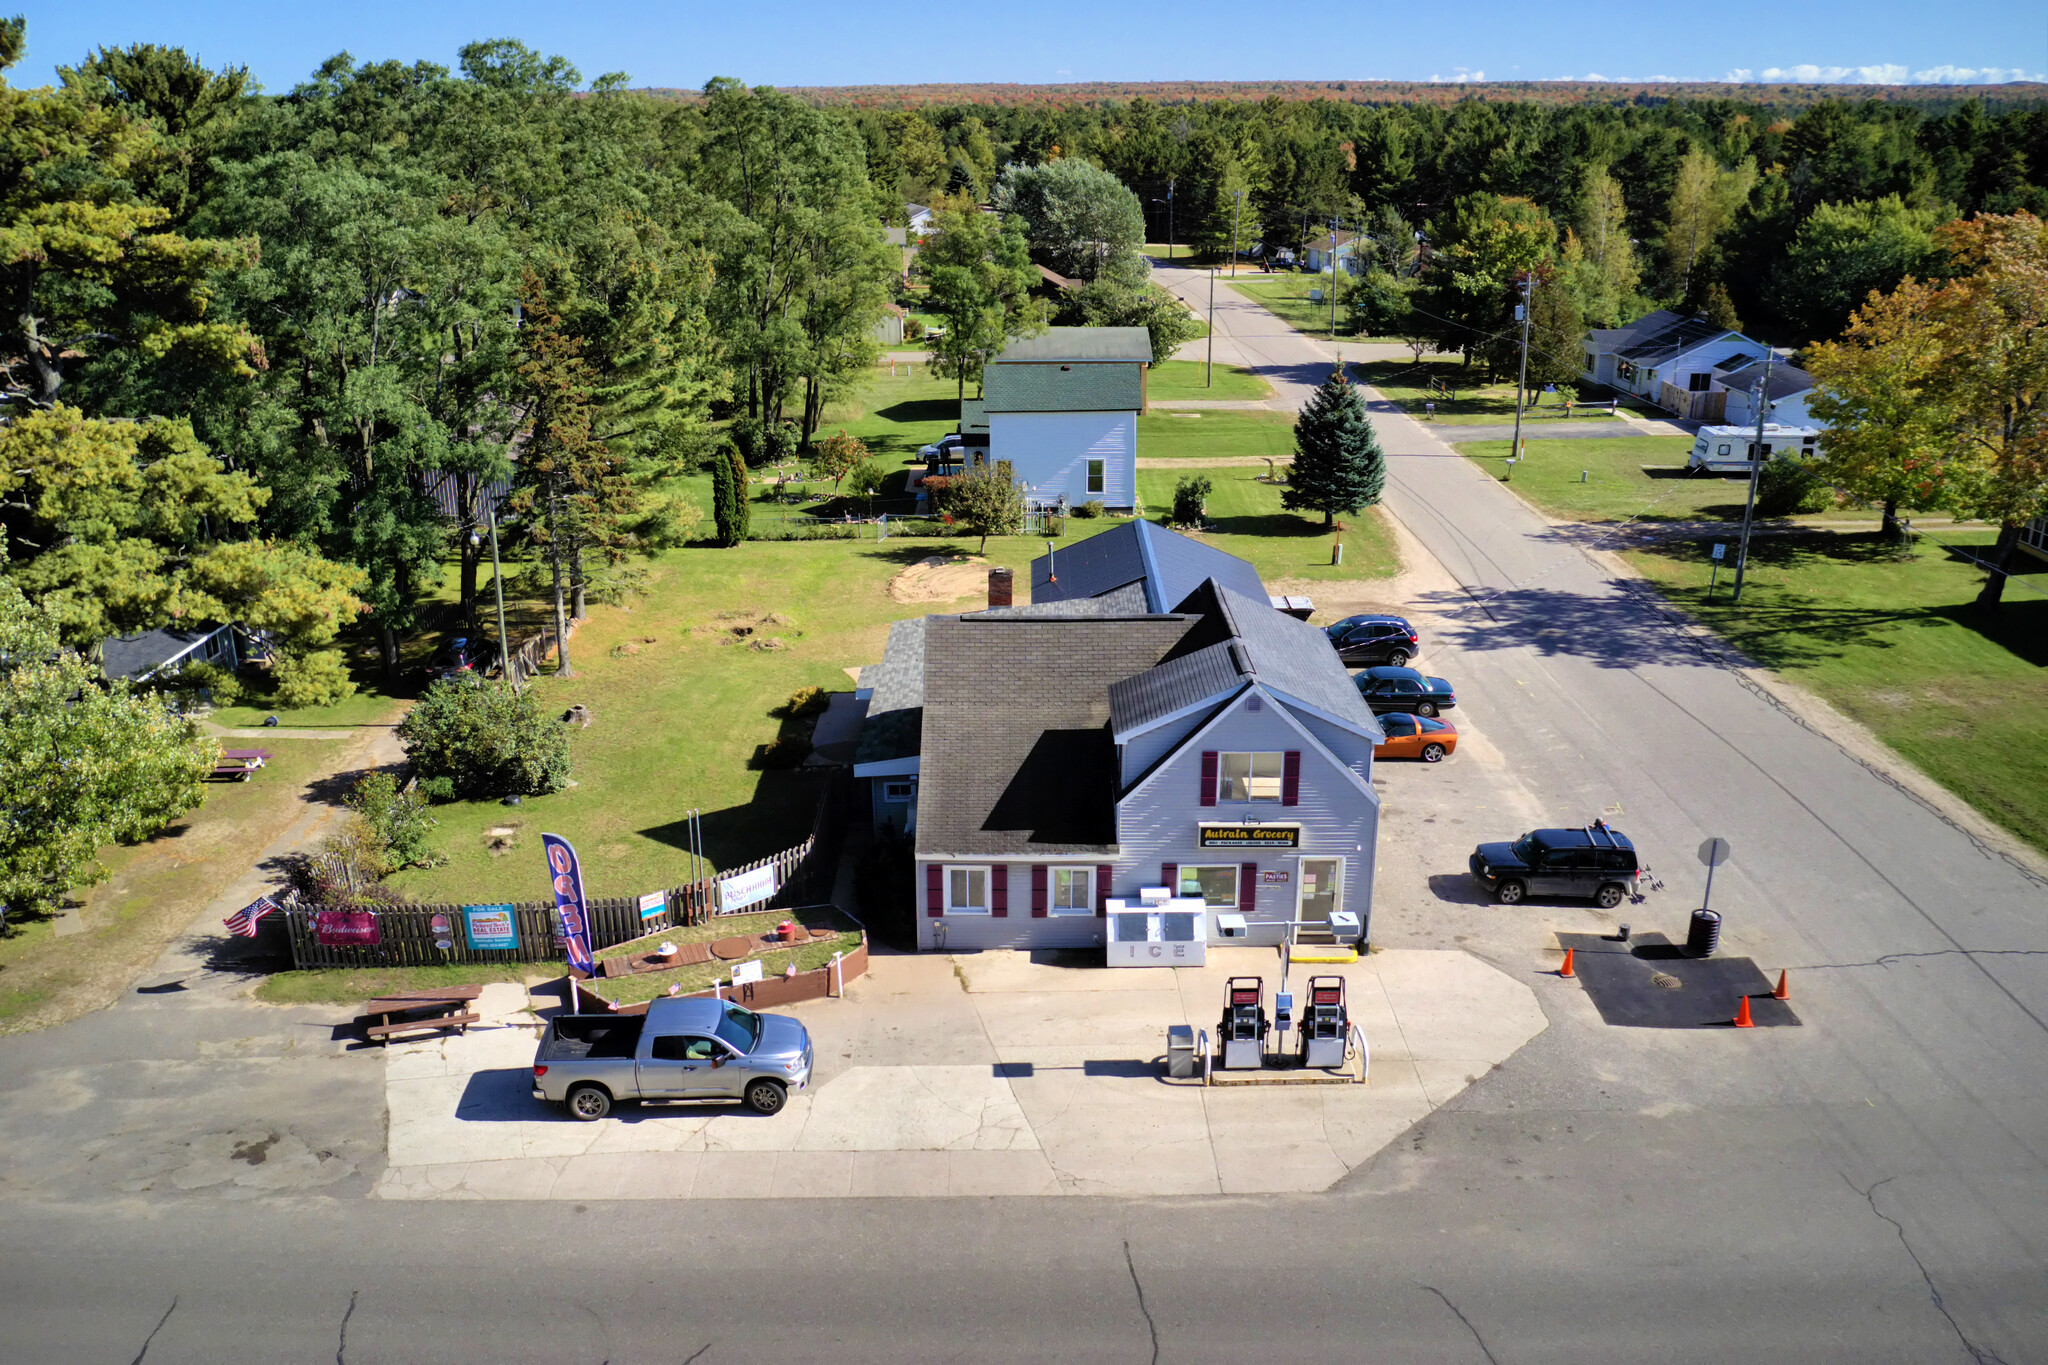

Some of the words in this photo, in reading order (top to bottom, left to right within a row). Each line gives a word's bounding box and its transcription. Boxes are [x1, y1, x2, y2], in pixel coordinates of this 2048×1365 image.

[1205, 829, 1248, 839] Autrain
[1253, 829, 1294, 840] Grocery
[319, 923, 375, 934] Budweiser
[1129, 944, 1185, 958] ICE
